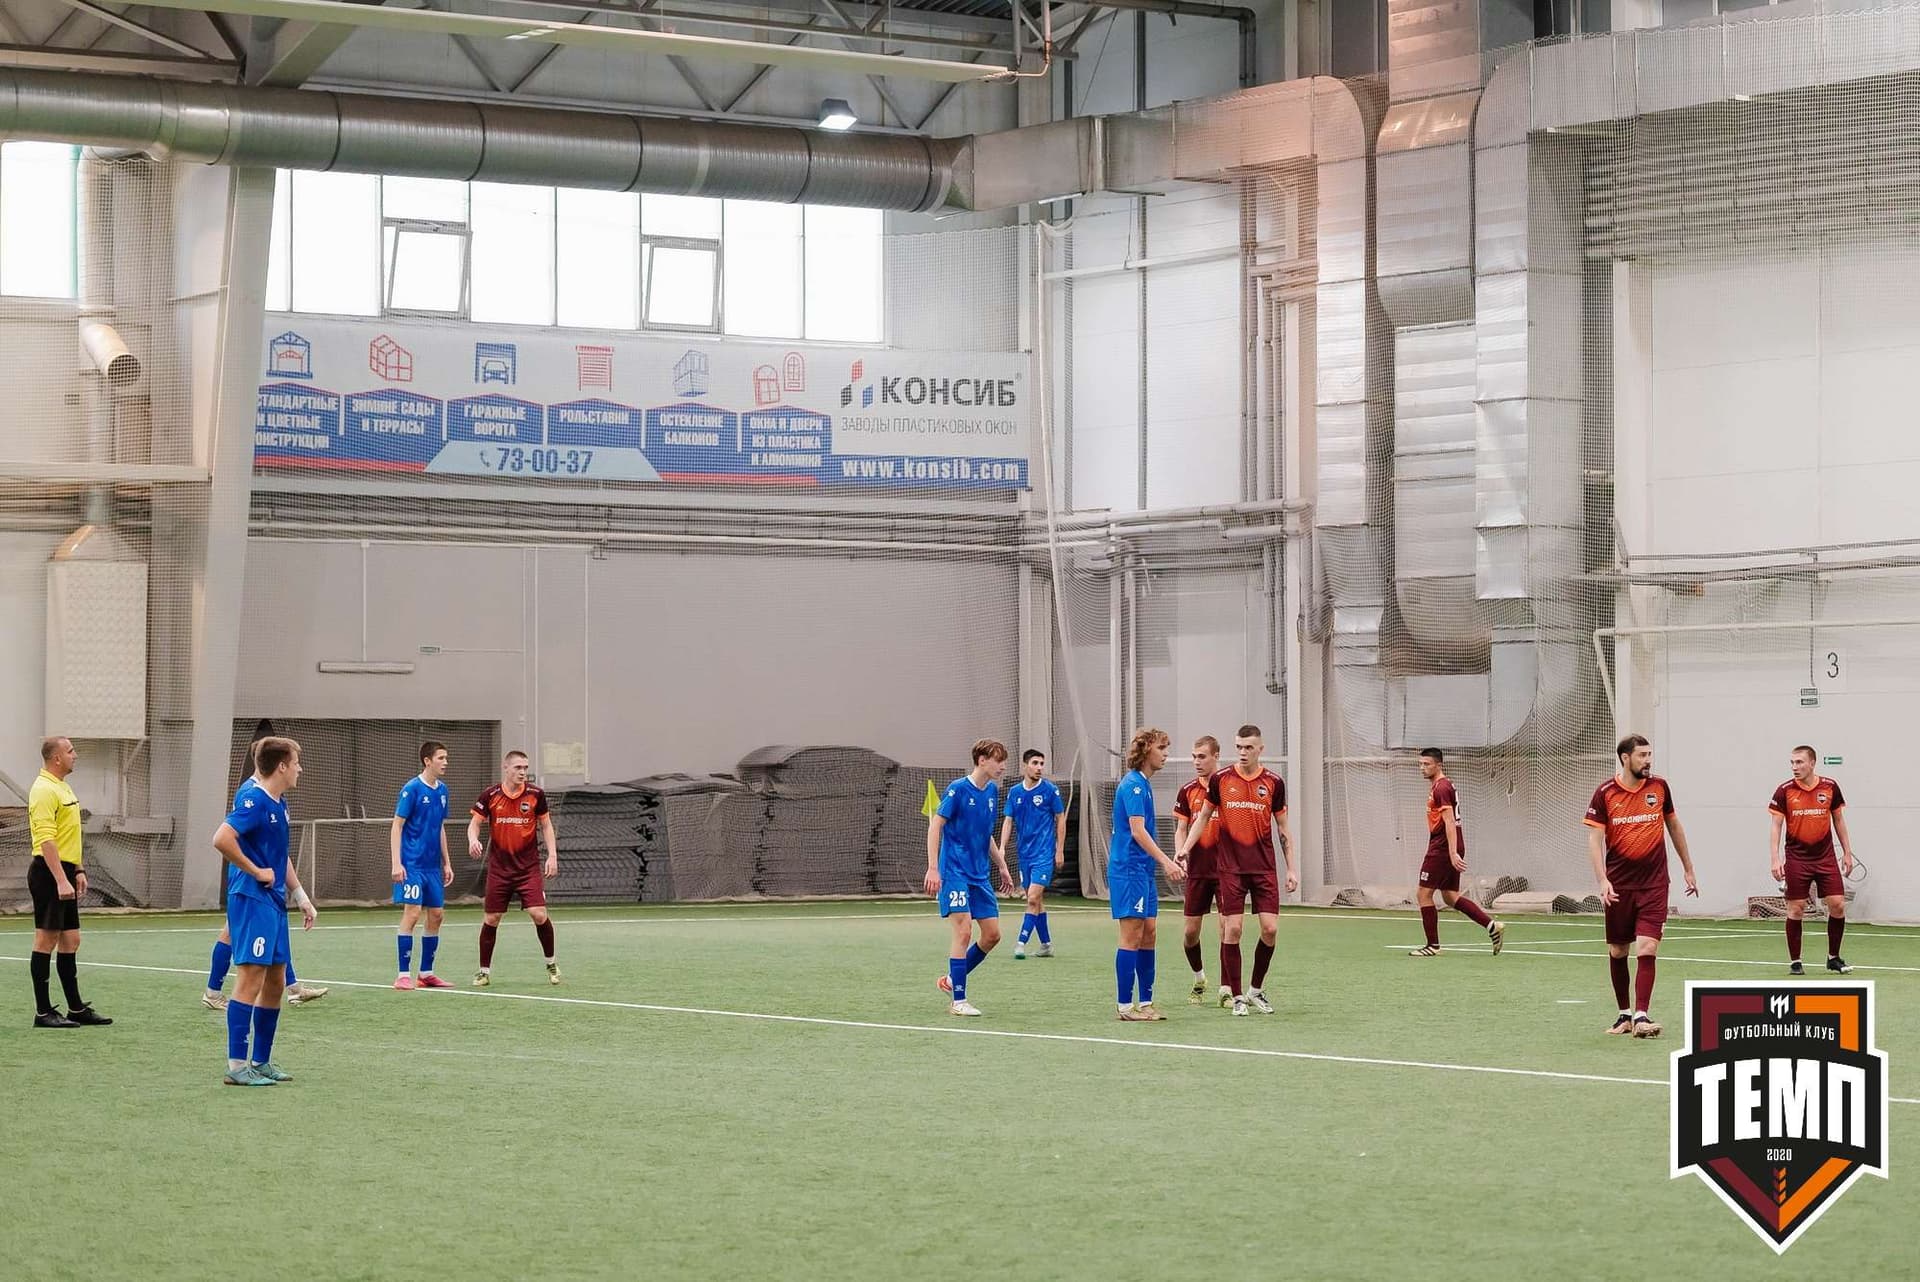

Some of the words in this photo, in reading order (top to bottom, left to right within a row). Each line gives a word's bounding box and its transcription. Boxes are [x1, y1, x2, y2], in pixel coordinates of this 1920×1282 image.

[882, 376, 1017, 407] КОНСИБ
[352, 399, 398, 414] ЗИМНИЕ
[401, 401, 435, 417] САДЫ
[464, 404, 526, 421] ГАРАЖНЫЕ
[560, 408, 630, 425] РОЛЬСТАВНИ
[267, 413, 320, 430] ЦВЕТНЫЕ
[362, 418, 369, 432] И
[374, 419, 424, 435] ТЕРРАСЫ
[660, 413, 723, 428] ОСТЕКЛЕНИЕ
[750, 417, 779, 430] ОКНА
[790, 417, 823, 431] ДВЕРИ
[842, 417, 890, 434] ЗАВОДЫ
[893, 418, 982, 434] ПЛАСТИКОВЫХ
[985, 419, 1017, 435] ОКОН
[474, 422, 517, 437] ВОРОТА
[664, 431, 719, 446] БАЛКОНОВ
[752, 433, 765, 447] ИЗ
[768, 434, 821, 449] ПЛАСТИКА
[496, 447, 594, 474] 73-00-37
[842, 457, 1019, 481] www.konsib.com
[1827, 652, 1839, 678] 3
[404, 884, 420, 899] 20
[949, 890, 966, 907] 25
[1134, 896, 1144, 913] 4
[253, 936, 265, 958] 6
